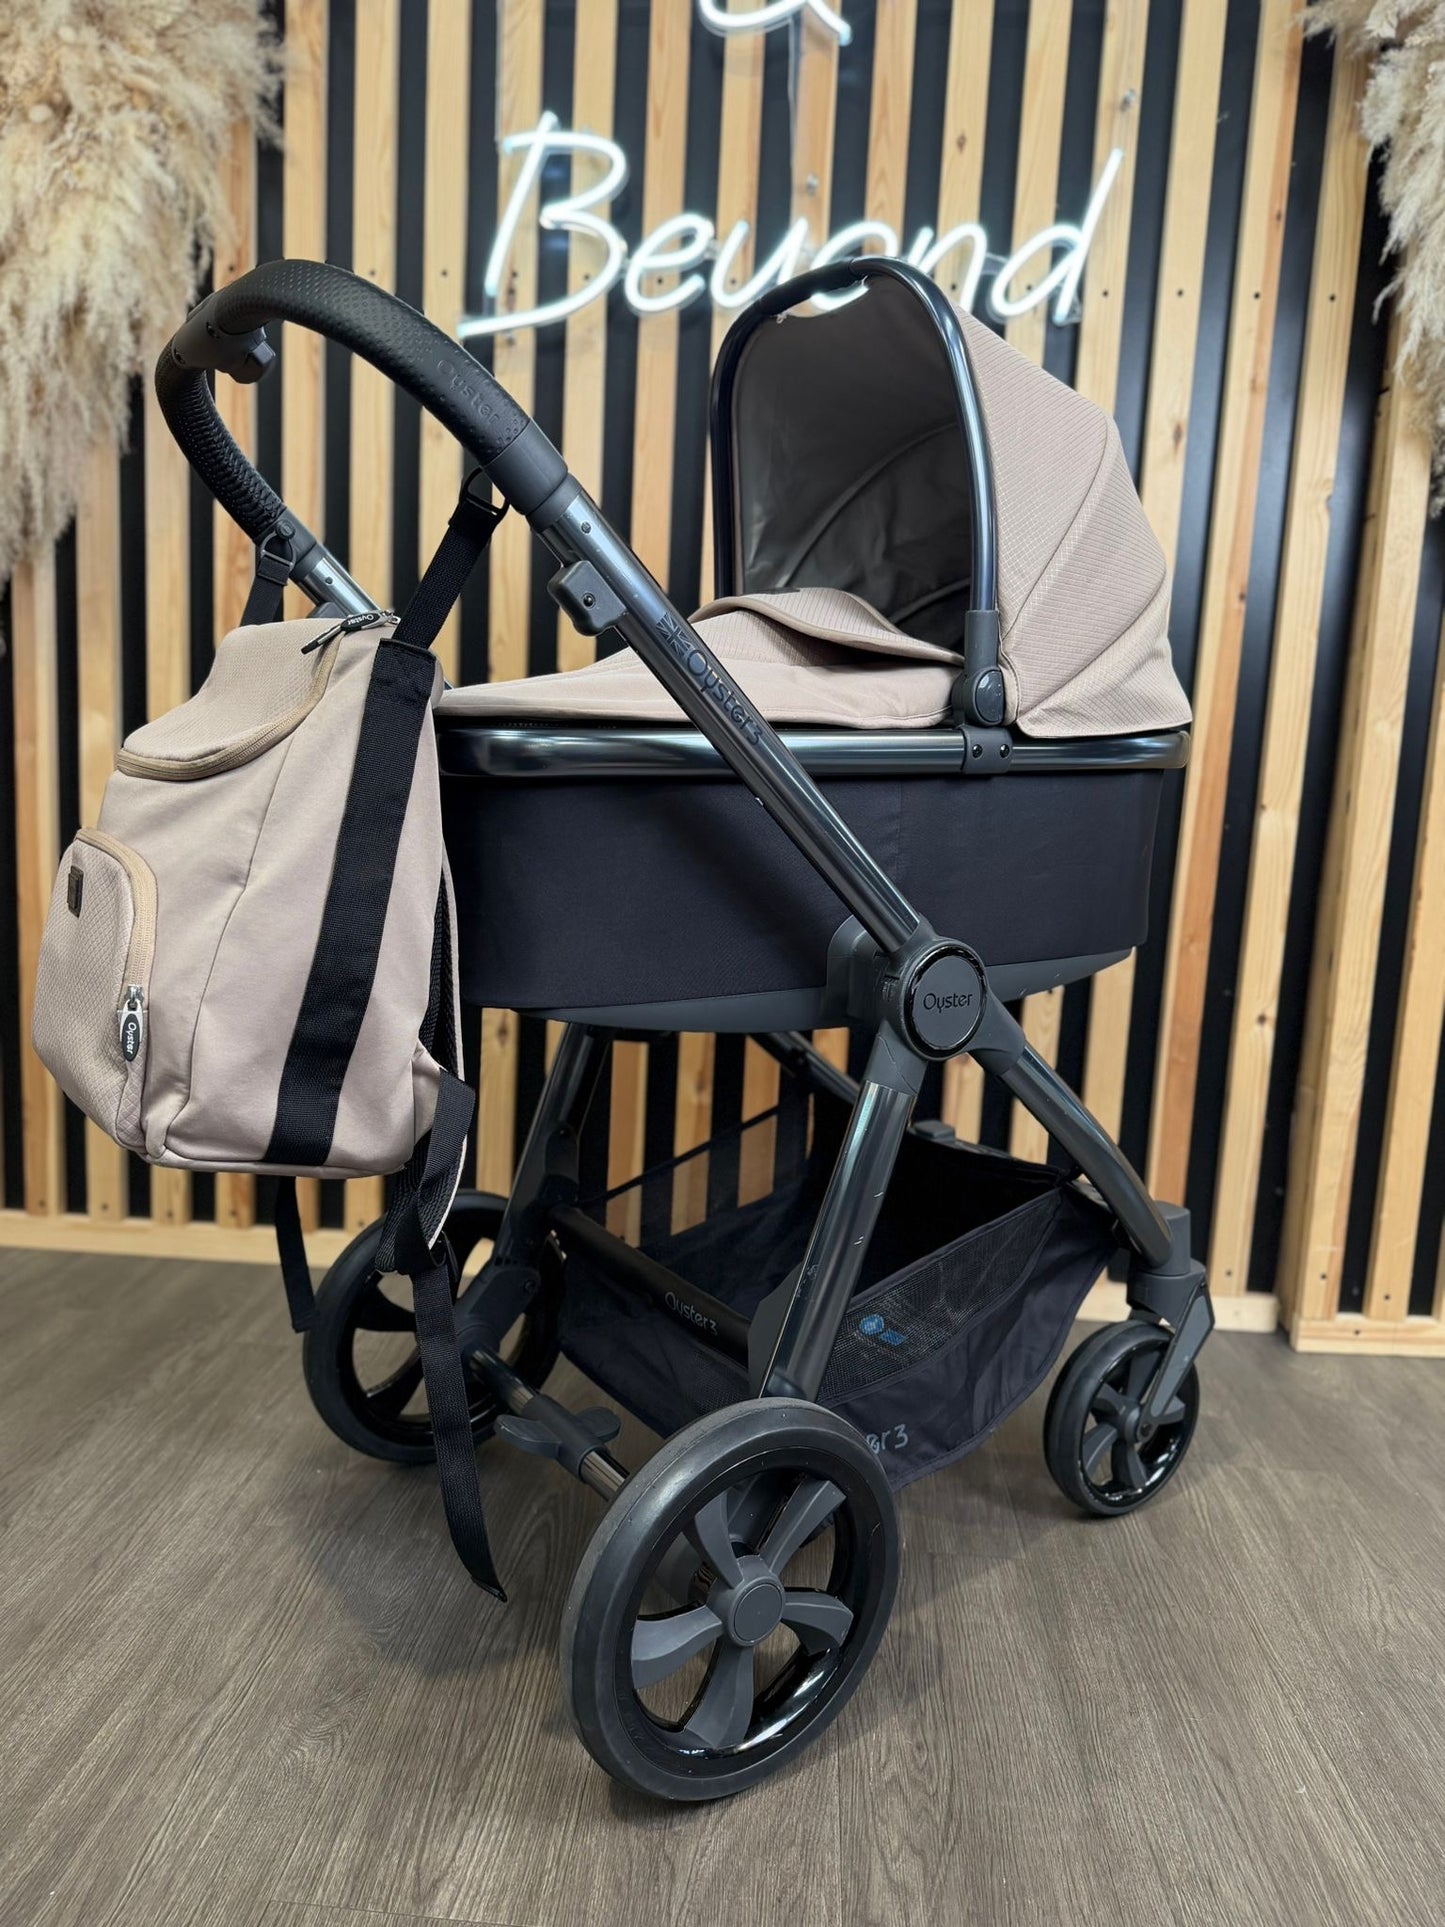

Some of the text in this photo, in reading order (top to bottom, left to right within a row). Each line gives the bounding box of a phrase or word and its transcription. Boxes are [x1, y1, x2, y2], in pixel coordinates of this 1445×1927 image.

[436, 359, 500, 424] Oyster
[346, 613, 375, 626] Oyster
[923, 992, 973, 1014] Oyster
[125, 1021, 138, 1055] Oyster
